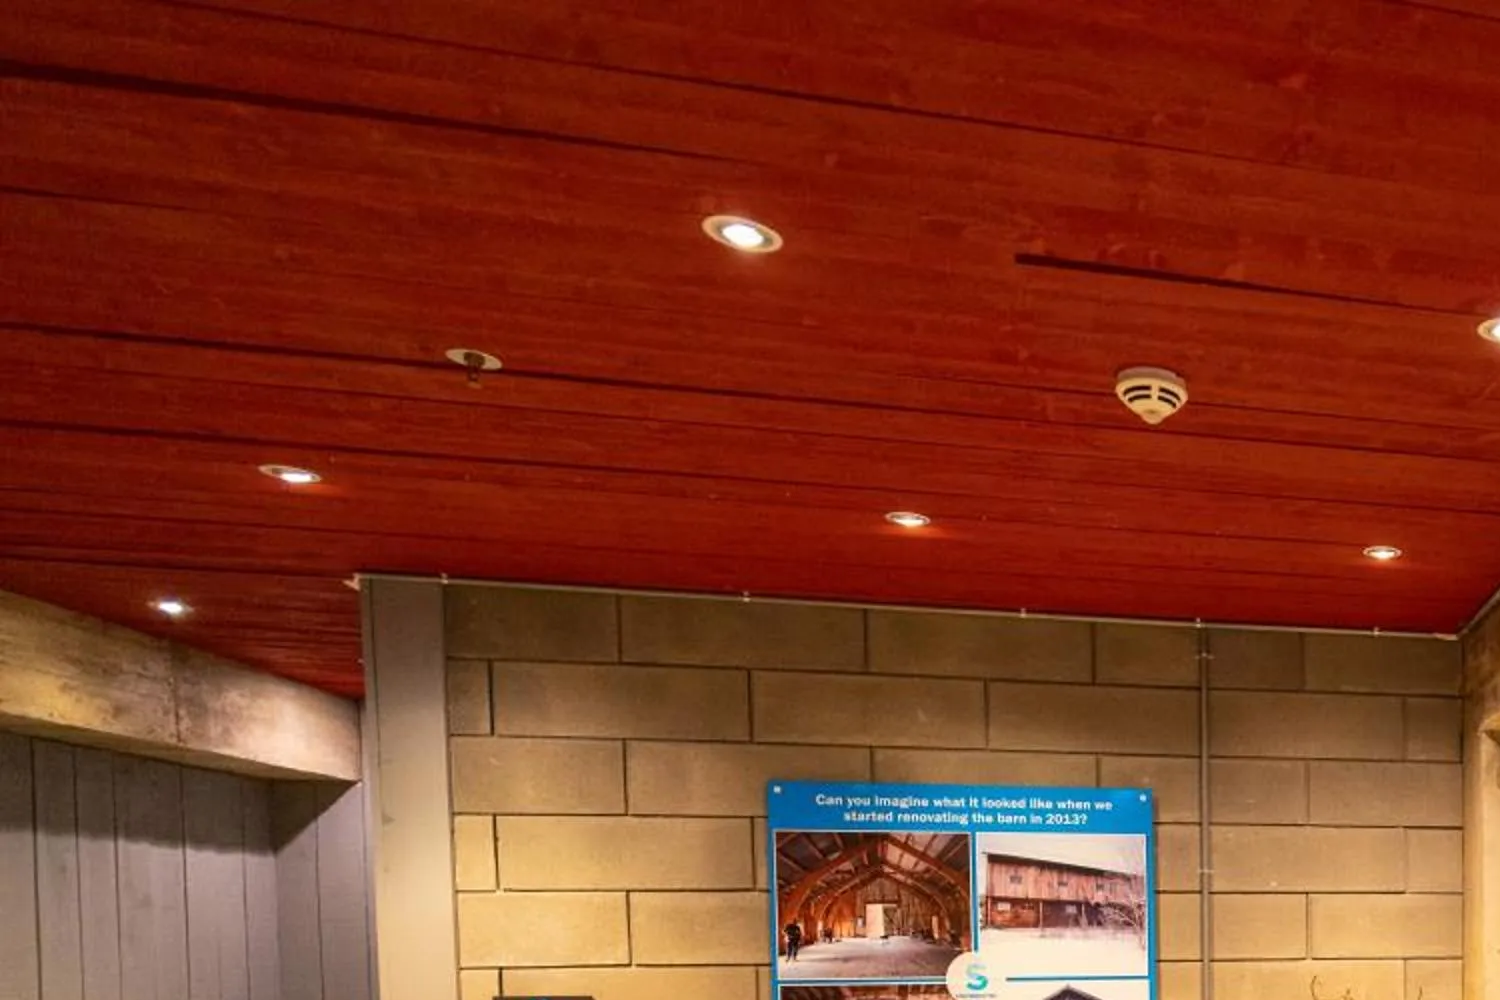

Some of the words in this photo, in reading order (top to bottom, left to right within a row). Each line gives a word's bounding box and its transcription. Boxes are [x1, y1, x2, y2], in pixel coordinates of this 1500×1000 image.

[815, 793, 844, 806] Can
[848, 796, 871, 809] you
[875, 795, 929, 809] imagine
[933, 796, 965, 808] what
[969, 796, 979, 808] it
[982, 797, 1027, 809] looked
[1029, 797, 1053, 809] like
[1056, 798, 1091, 811] when
[1094, 801, 1113, 811] we
[843, 811, 893, 823] started
[897, 811, 969, 826] renovating
[972, 812, 994, 824] the
[997, 812, 1027, 825] barn
[1030, 813, 1043, 825] in
[1045, 813, 1088, 826] 2013?
